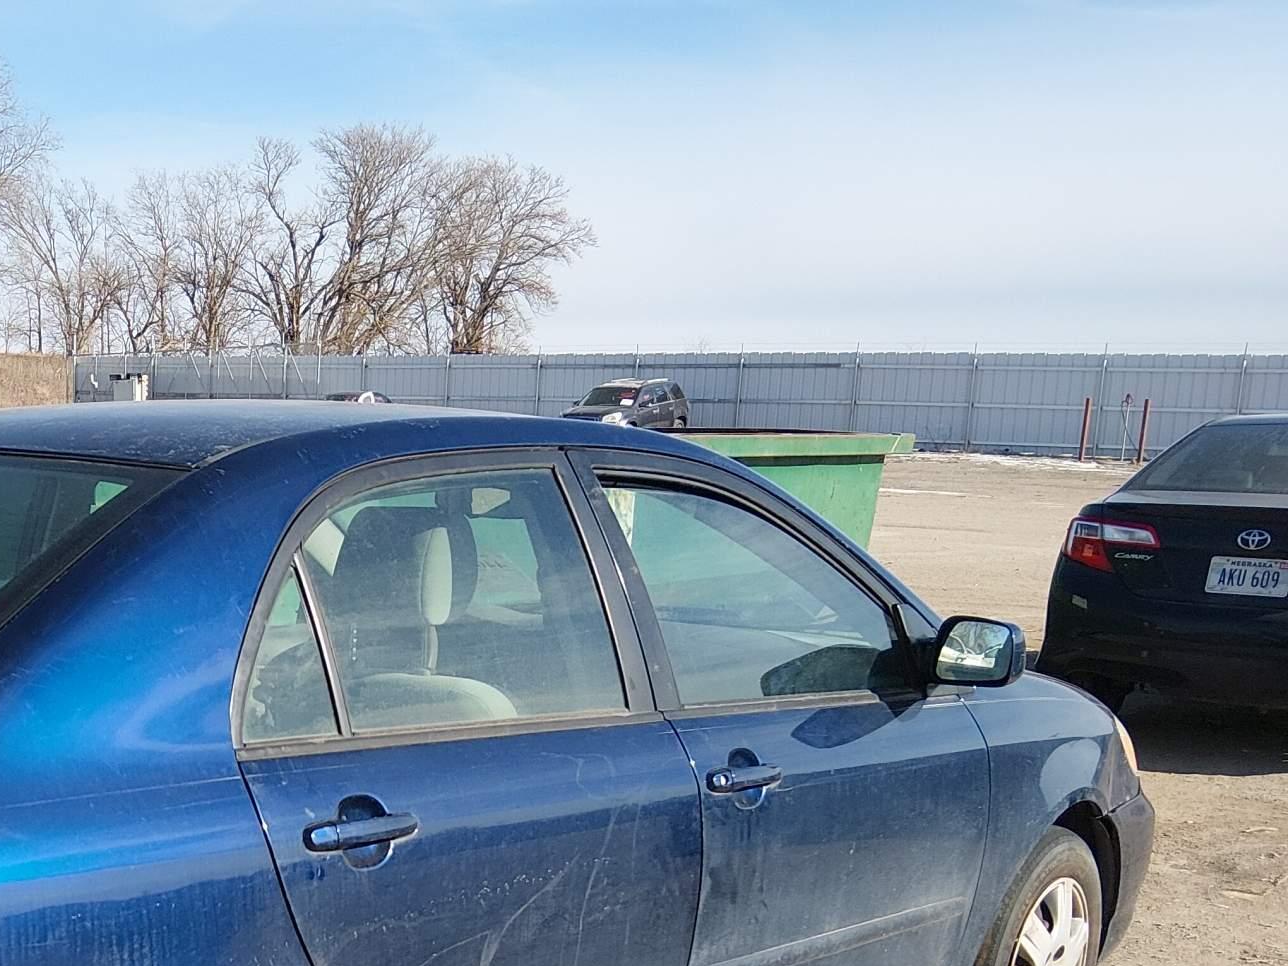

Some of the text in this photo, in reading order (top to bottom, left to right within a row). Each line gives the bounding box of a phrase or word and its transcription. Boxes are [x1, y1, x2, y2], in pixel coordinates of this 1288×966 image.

[1230, 560, 1273, 569] NEBRASKA
[1217, 567, 1281, 589] AKU 609
